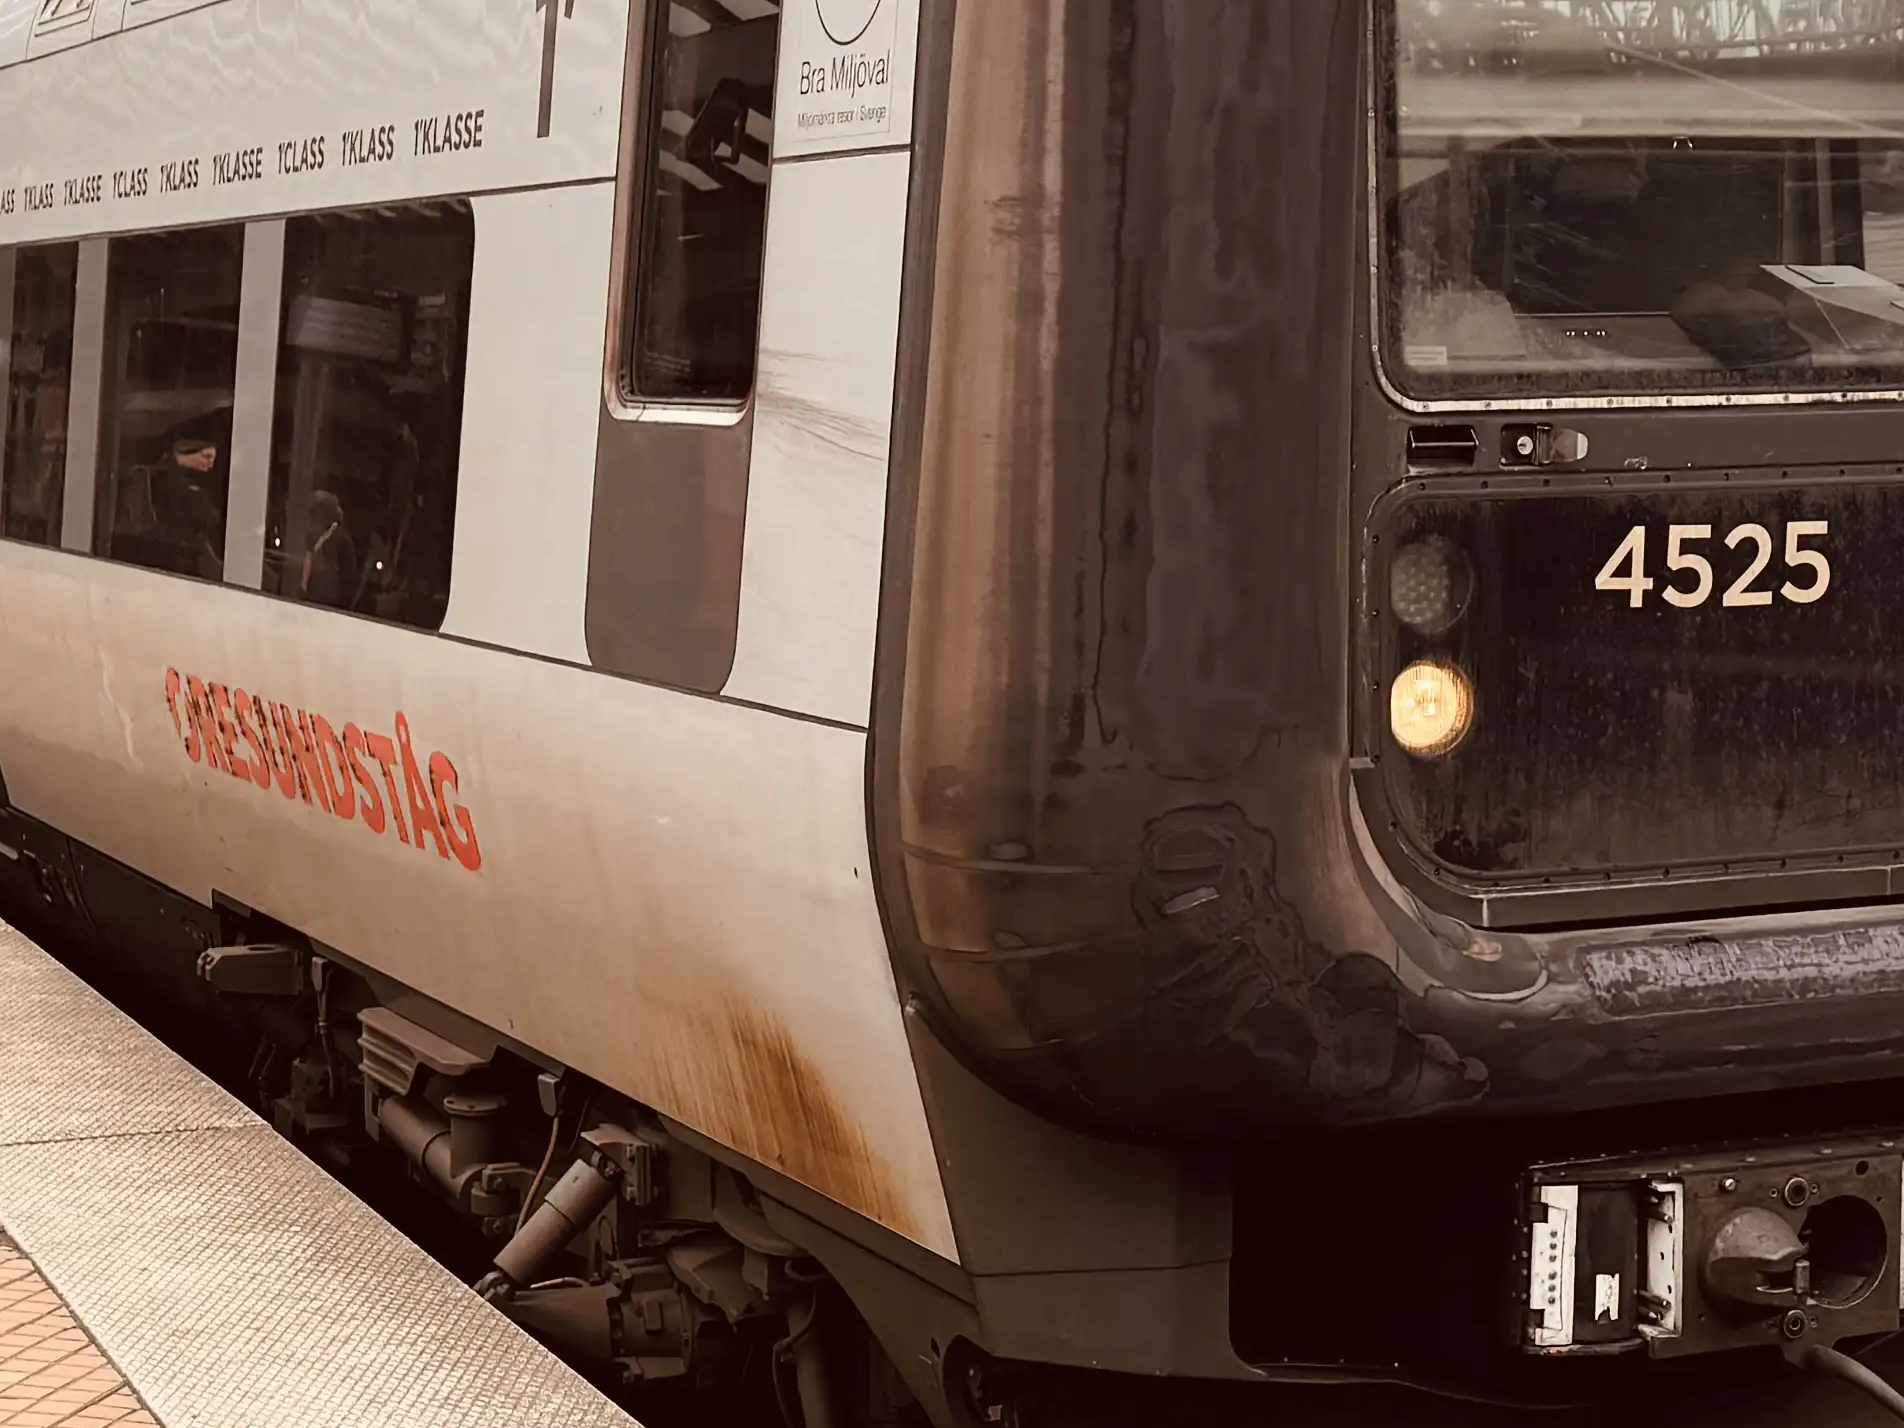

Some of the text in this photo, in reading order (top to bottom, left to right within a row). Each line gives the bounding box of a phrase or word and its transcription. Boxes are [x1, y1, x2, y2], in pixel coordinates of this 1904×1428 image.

[800, 48, 890, 99] Bra Miljöval
[1595, 520, 1831, 608] 4525
